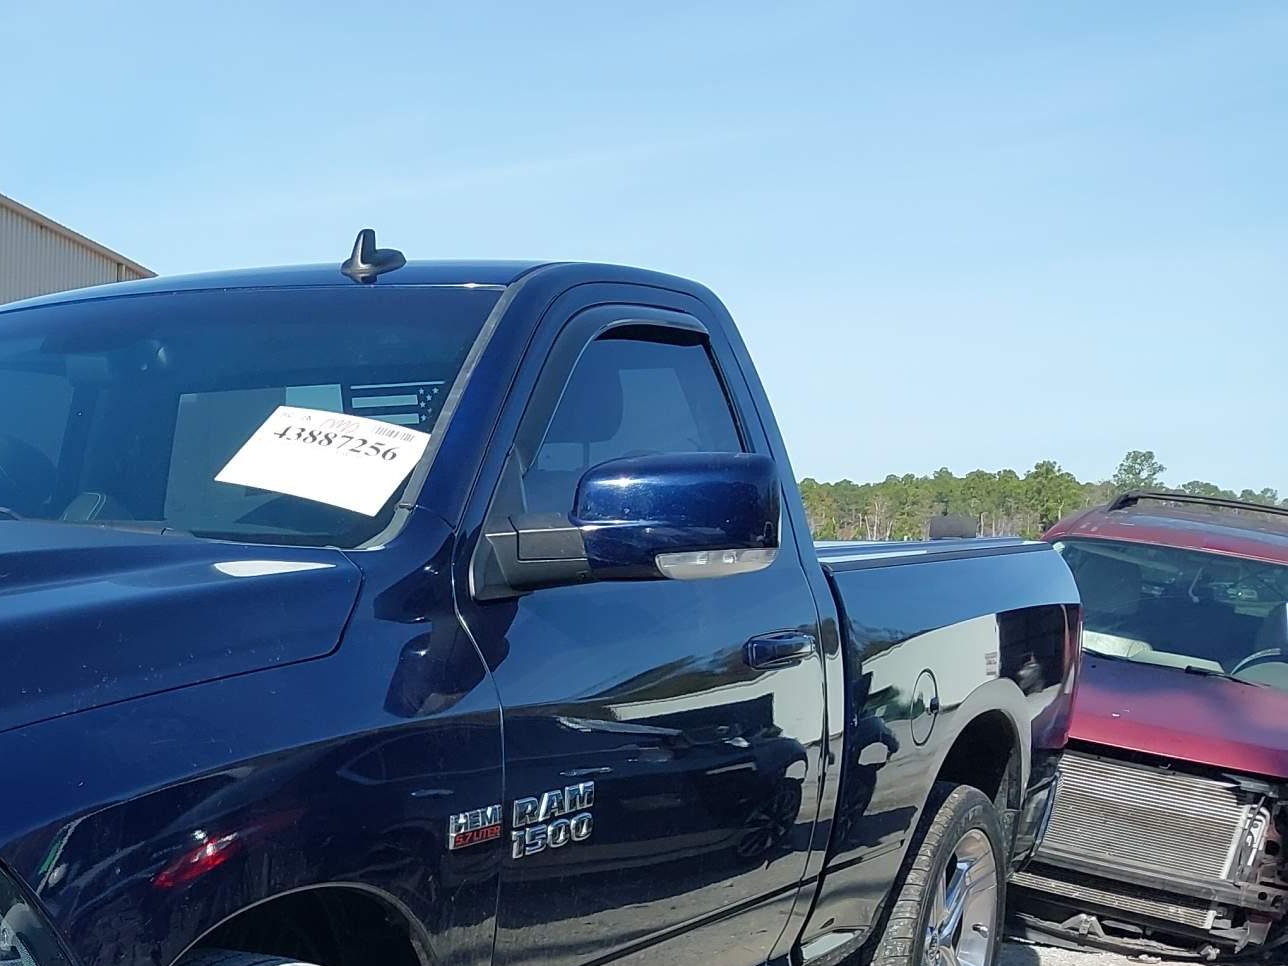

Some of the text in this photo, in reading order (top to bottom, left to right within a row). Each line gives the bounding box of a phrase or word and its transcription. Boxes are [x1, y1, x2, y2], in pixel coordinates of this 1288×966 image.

[273, 424, 398, 462] 43887256
[449, 804, 503, 835] HEMI
[512, 780, 595, 829] RAM
[473, 825, 501, 843] LITER
[511, 811, 594, 859] 1500
